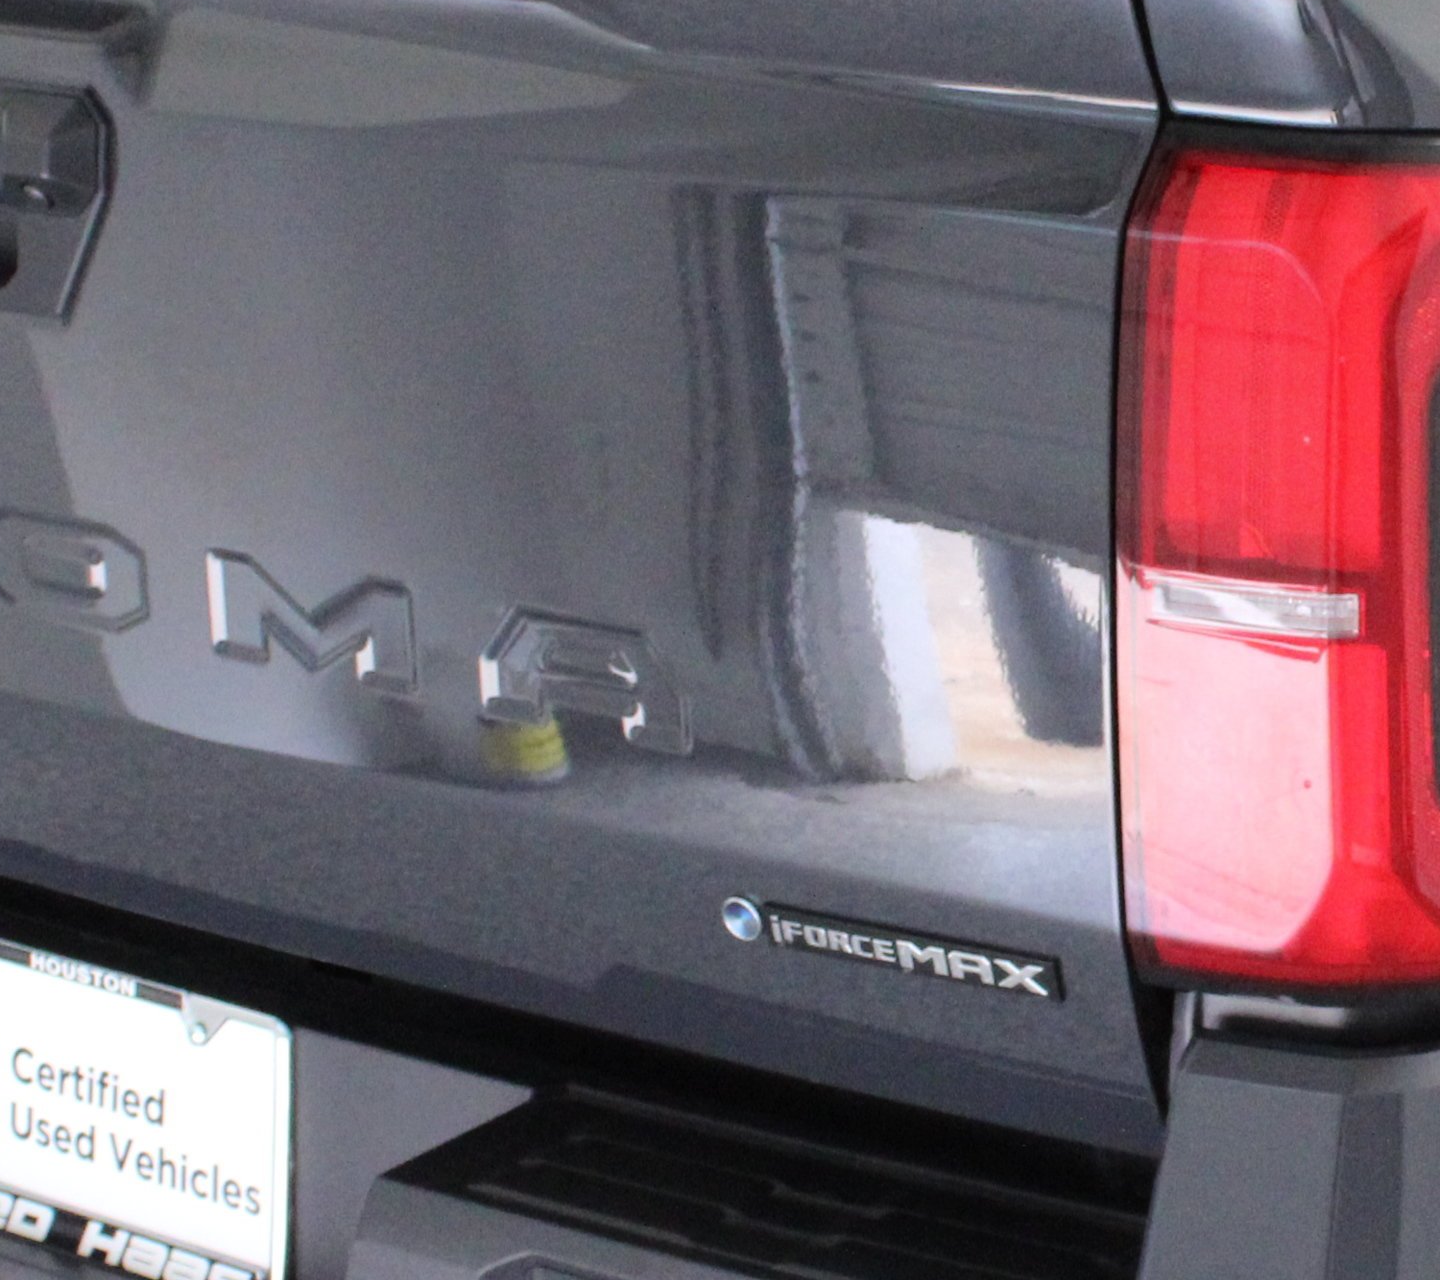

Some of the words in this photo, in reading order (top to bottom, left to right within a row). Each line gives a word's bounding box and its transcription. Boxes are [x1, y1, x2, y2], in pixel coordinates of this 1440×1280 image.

[28, 951, 137, 998] HOUSTON
[11, 1046, 166, 1127] Certified
[10, 1101, 97, 1162] Used
[109, 1132, 262, 1216] Vehicles
